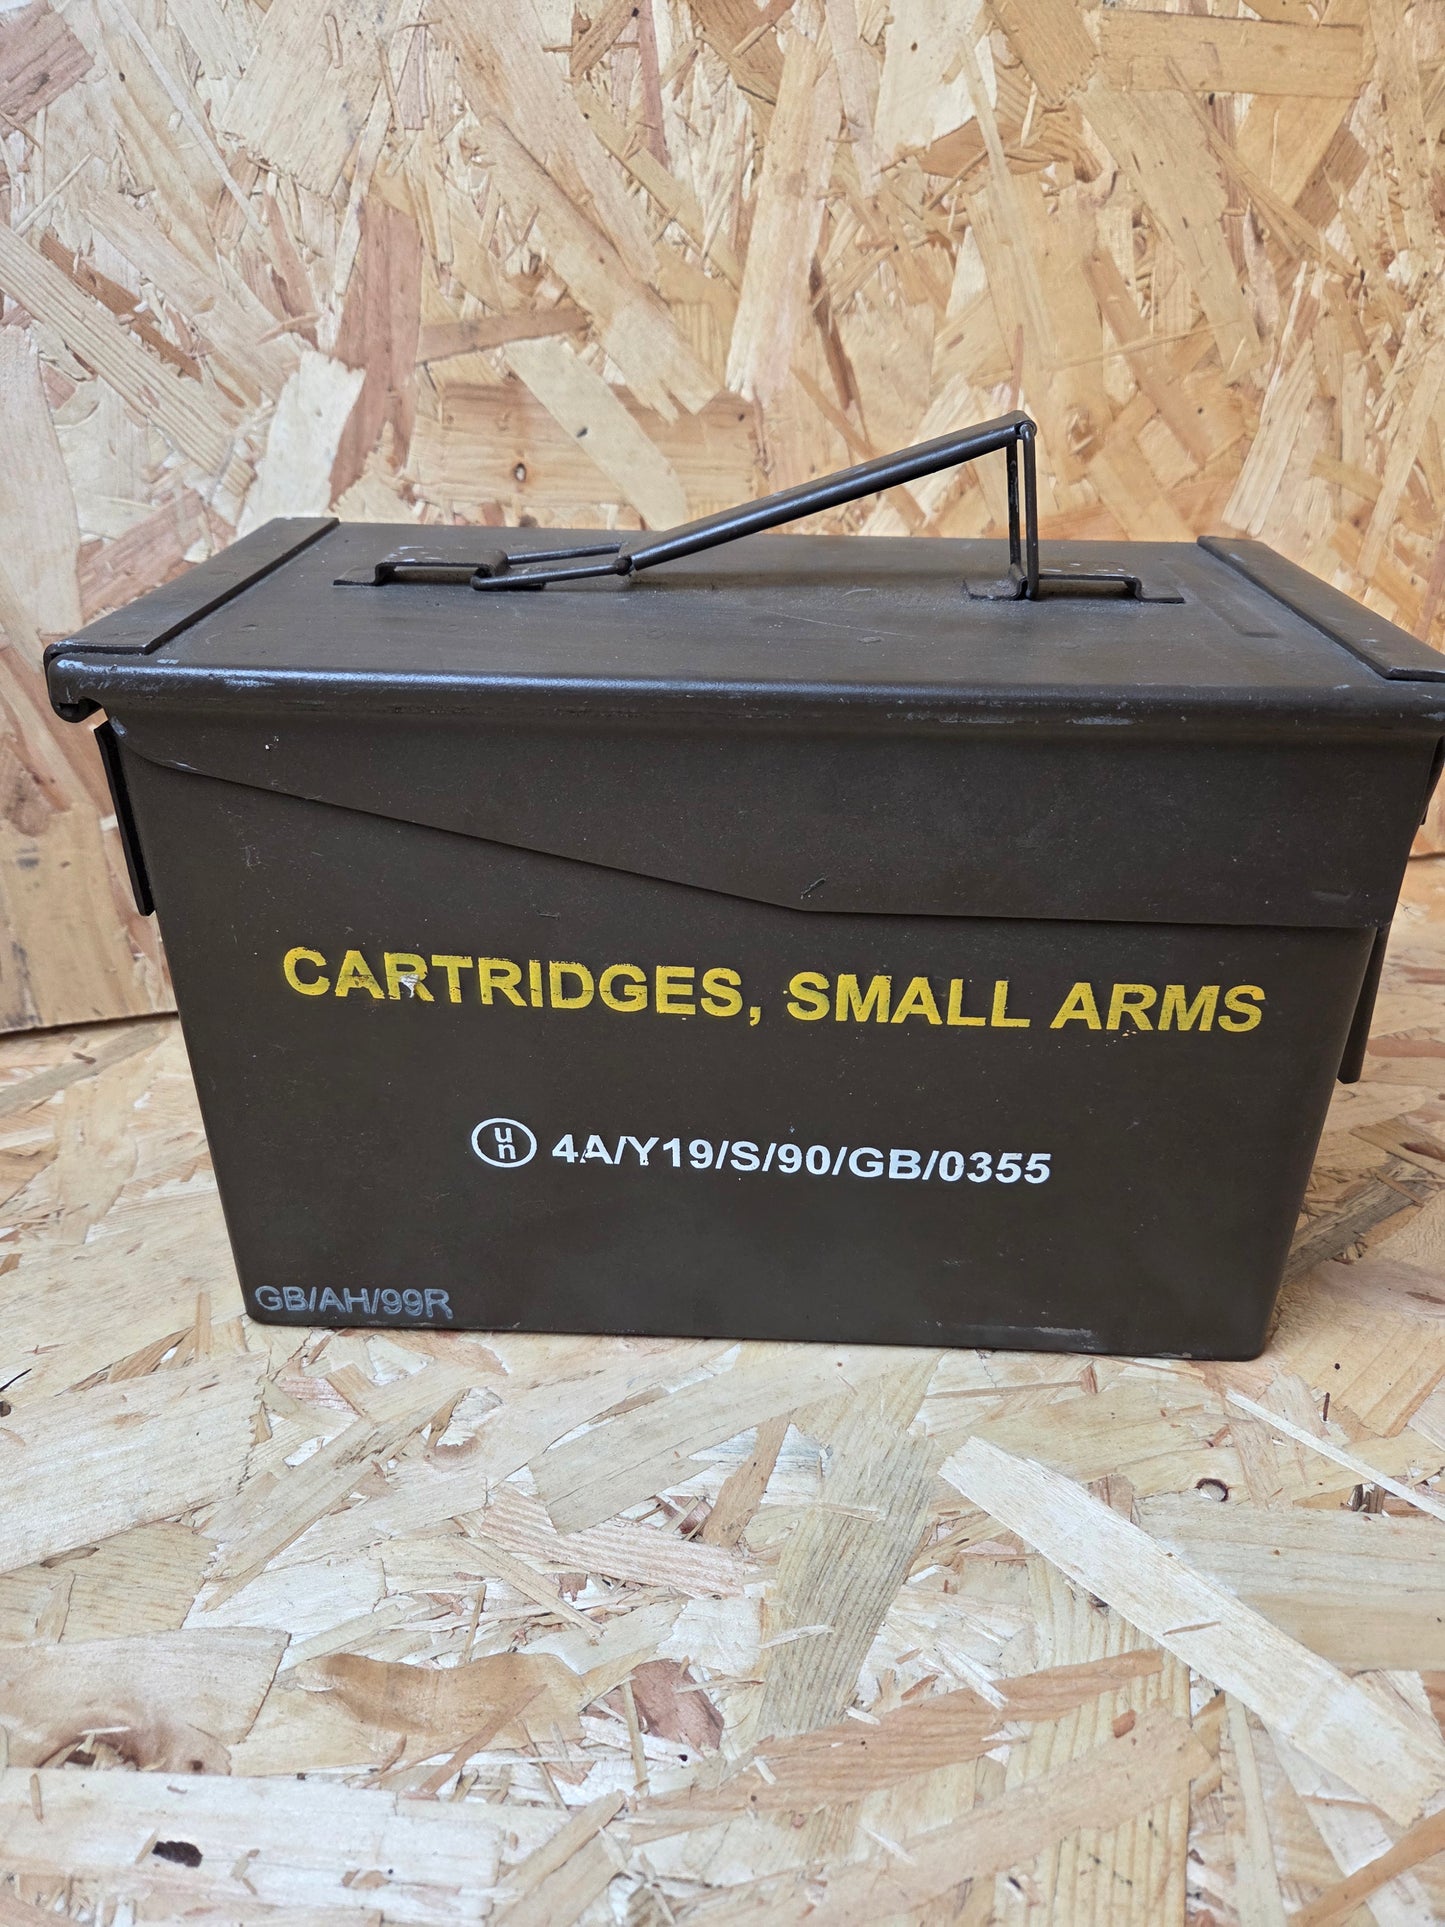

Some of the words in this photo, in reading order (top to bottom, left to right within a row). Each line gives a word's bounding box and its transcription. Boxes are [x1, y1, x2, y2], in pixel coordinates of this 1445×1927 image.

[282, 946, 762, 1027] CARTRIDGES,
[786, 971, 1031, 1028] SMALL
[1049, 982, 1266, 1033] ARMS
[551, 1133, 1052, 1184] 4A/Y19/S/90/GB/0355
[254, 1285, 453, 1319] GB/AH/99R
